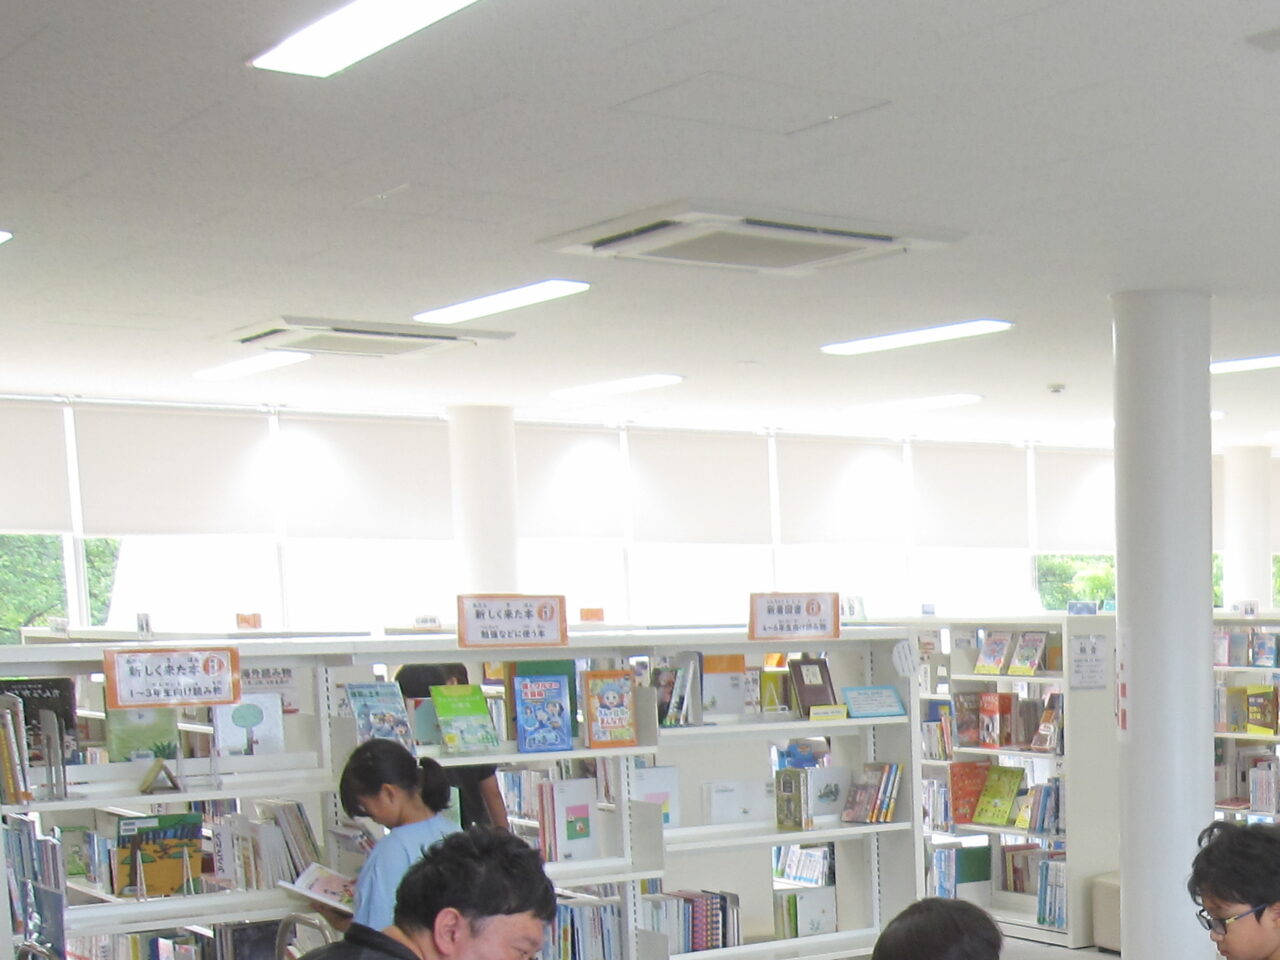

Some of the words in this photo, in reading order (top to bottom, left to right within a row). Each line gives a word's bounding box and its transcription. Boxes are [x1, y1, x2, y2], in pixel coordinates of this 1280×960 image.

[474, 609, 534, 619] 新しく来た本
[128, 664, 200, 676] 新しく来た本
